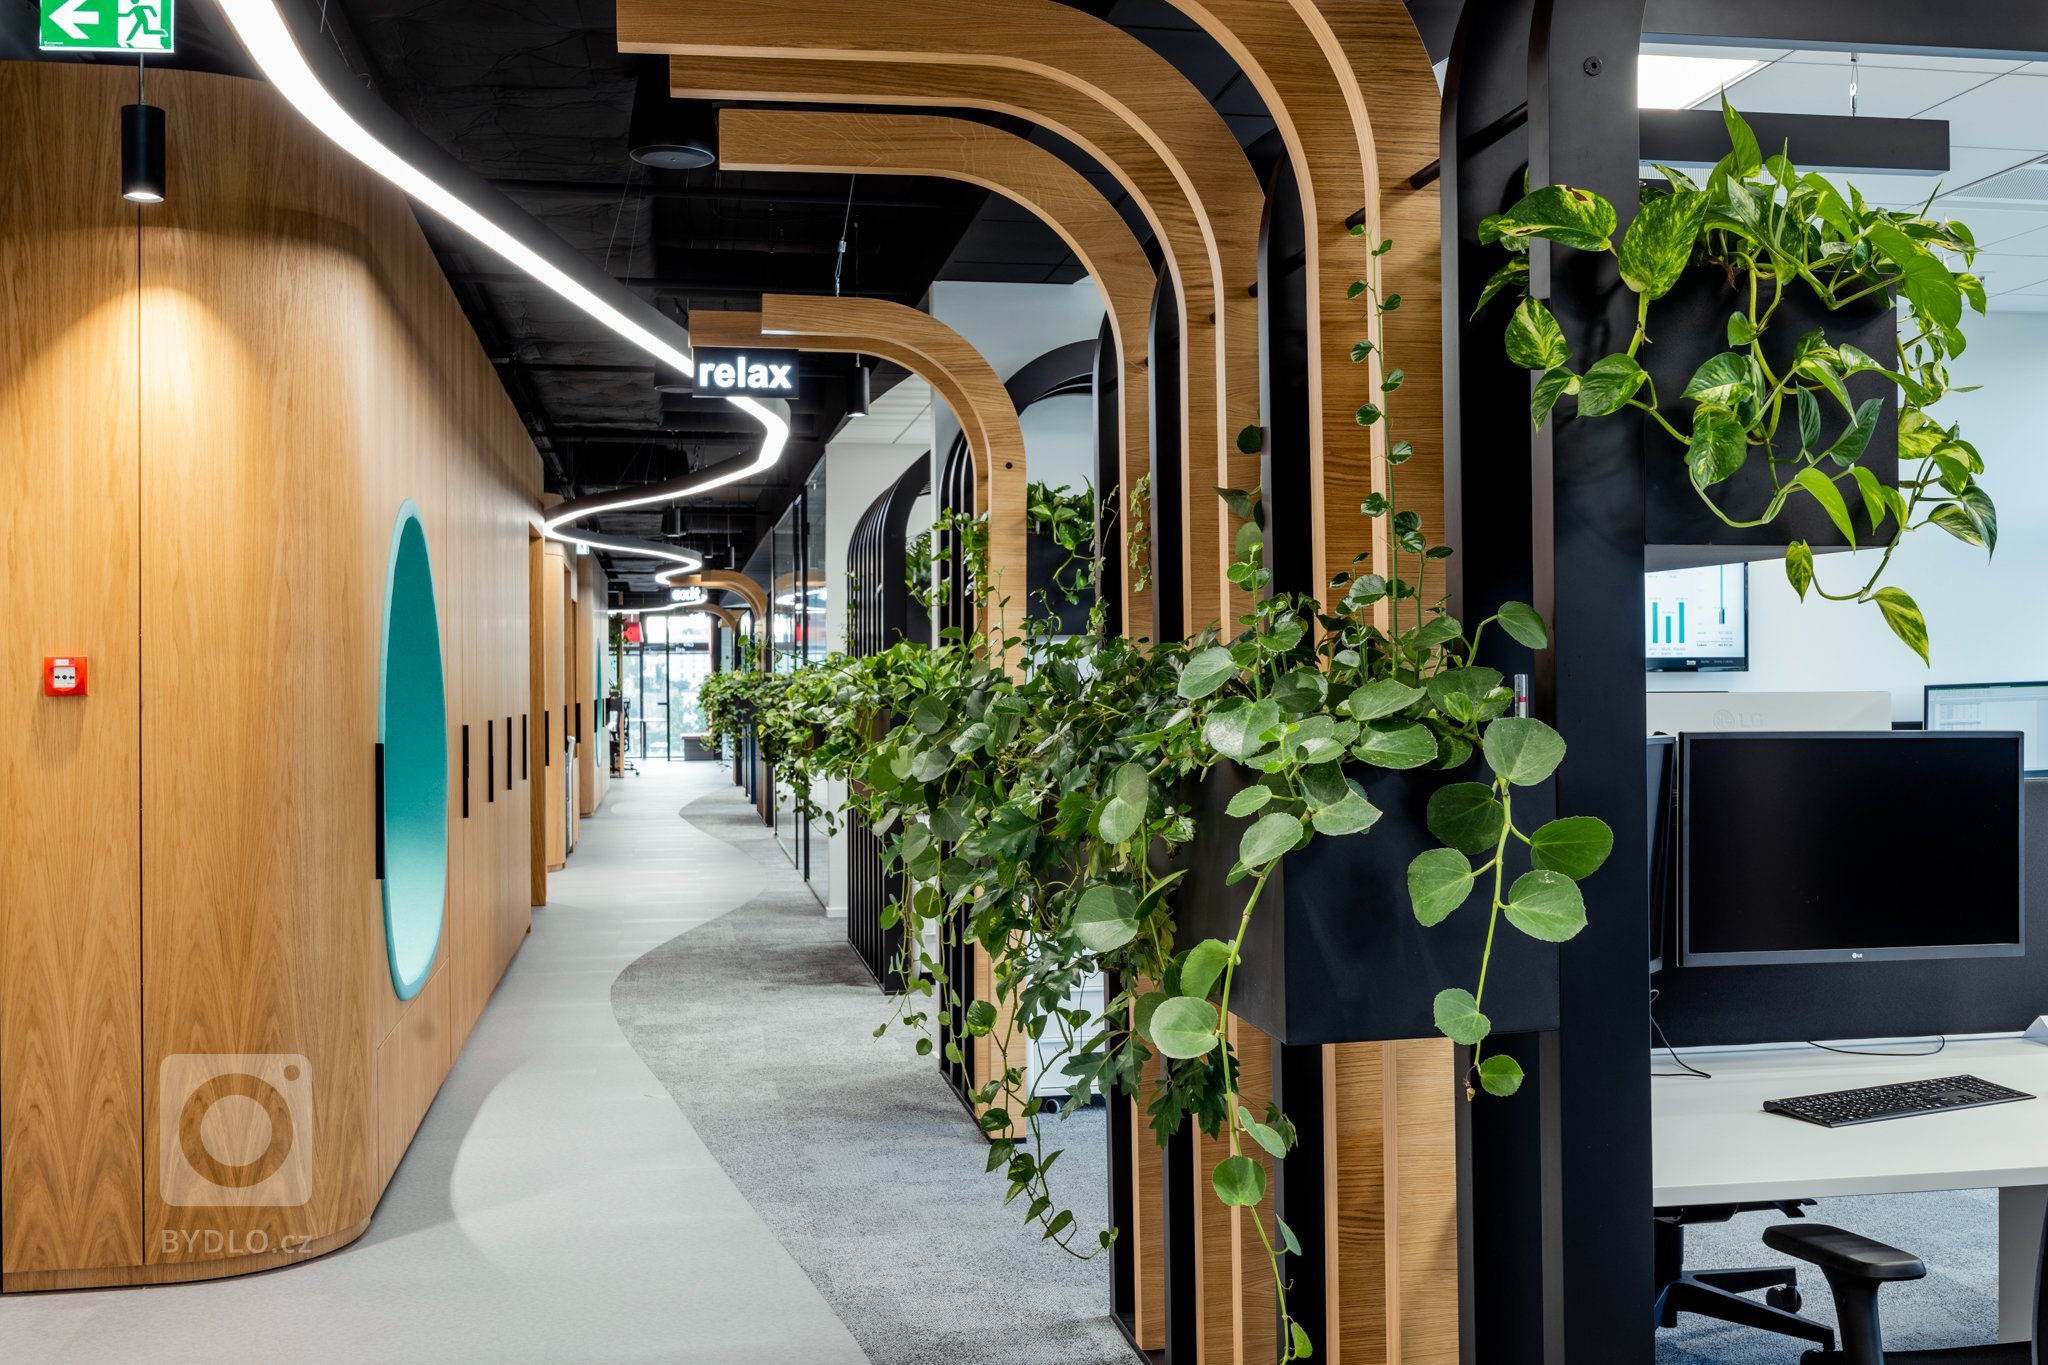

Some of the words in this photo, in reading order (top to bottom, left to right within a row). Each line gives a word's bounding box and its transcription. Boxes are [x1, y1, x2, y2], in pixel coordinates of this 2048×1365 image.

[699, 356, 792, 388] relax
[671, 586, 701, 601] exit
[1739, 712, 1763, 729] LG
